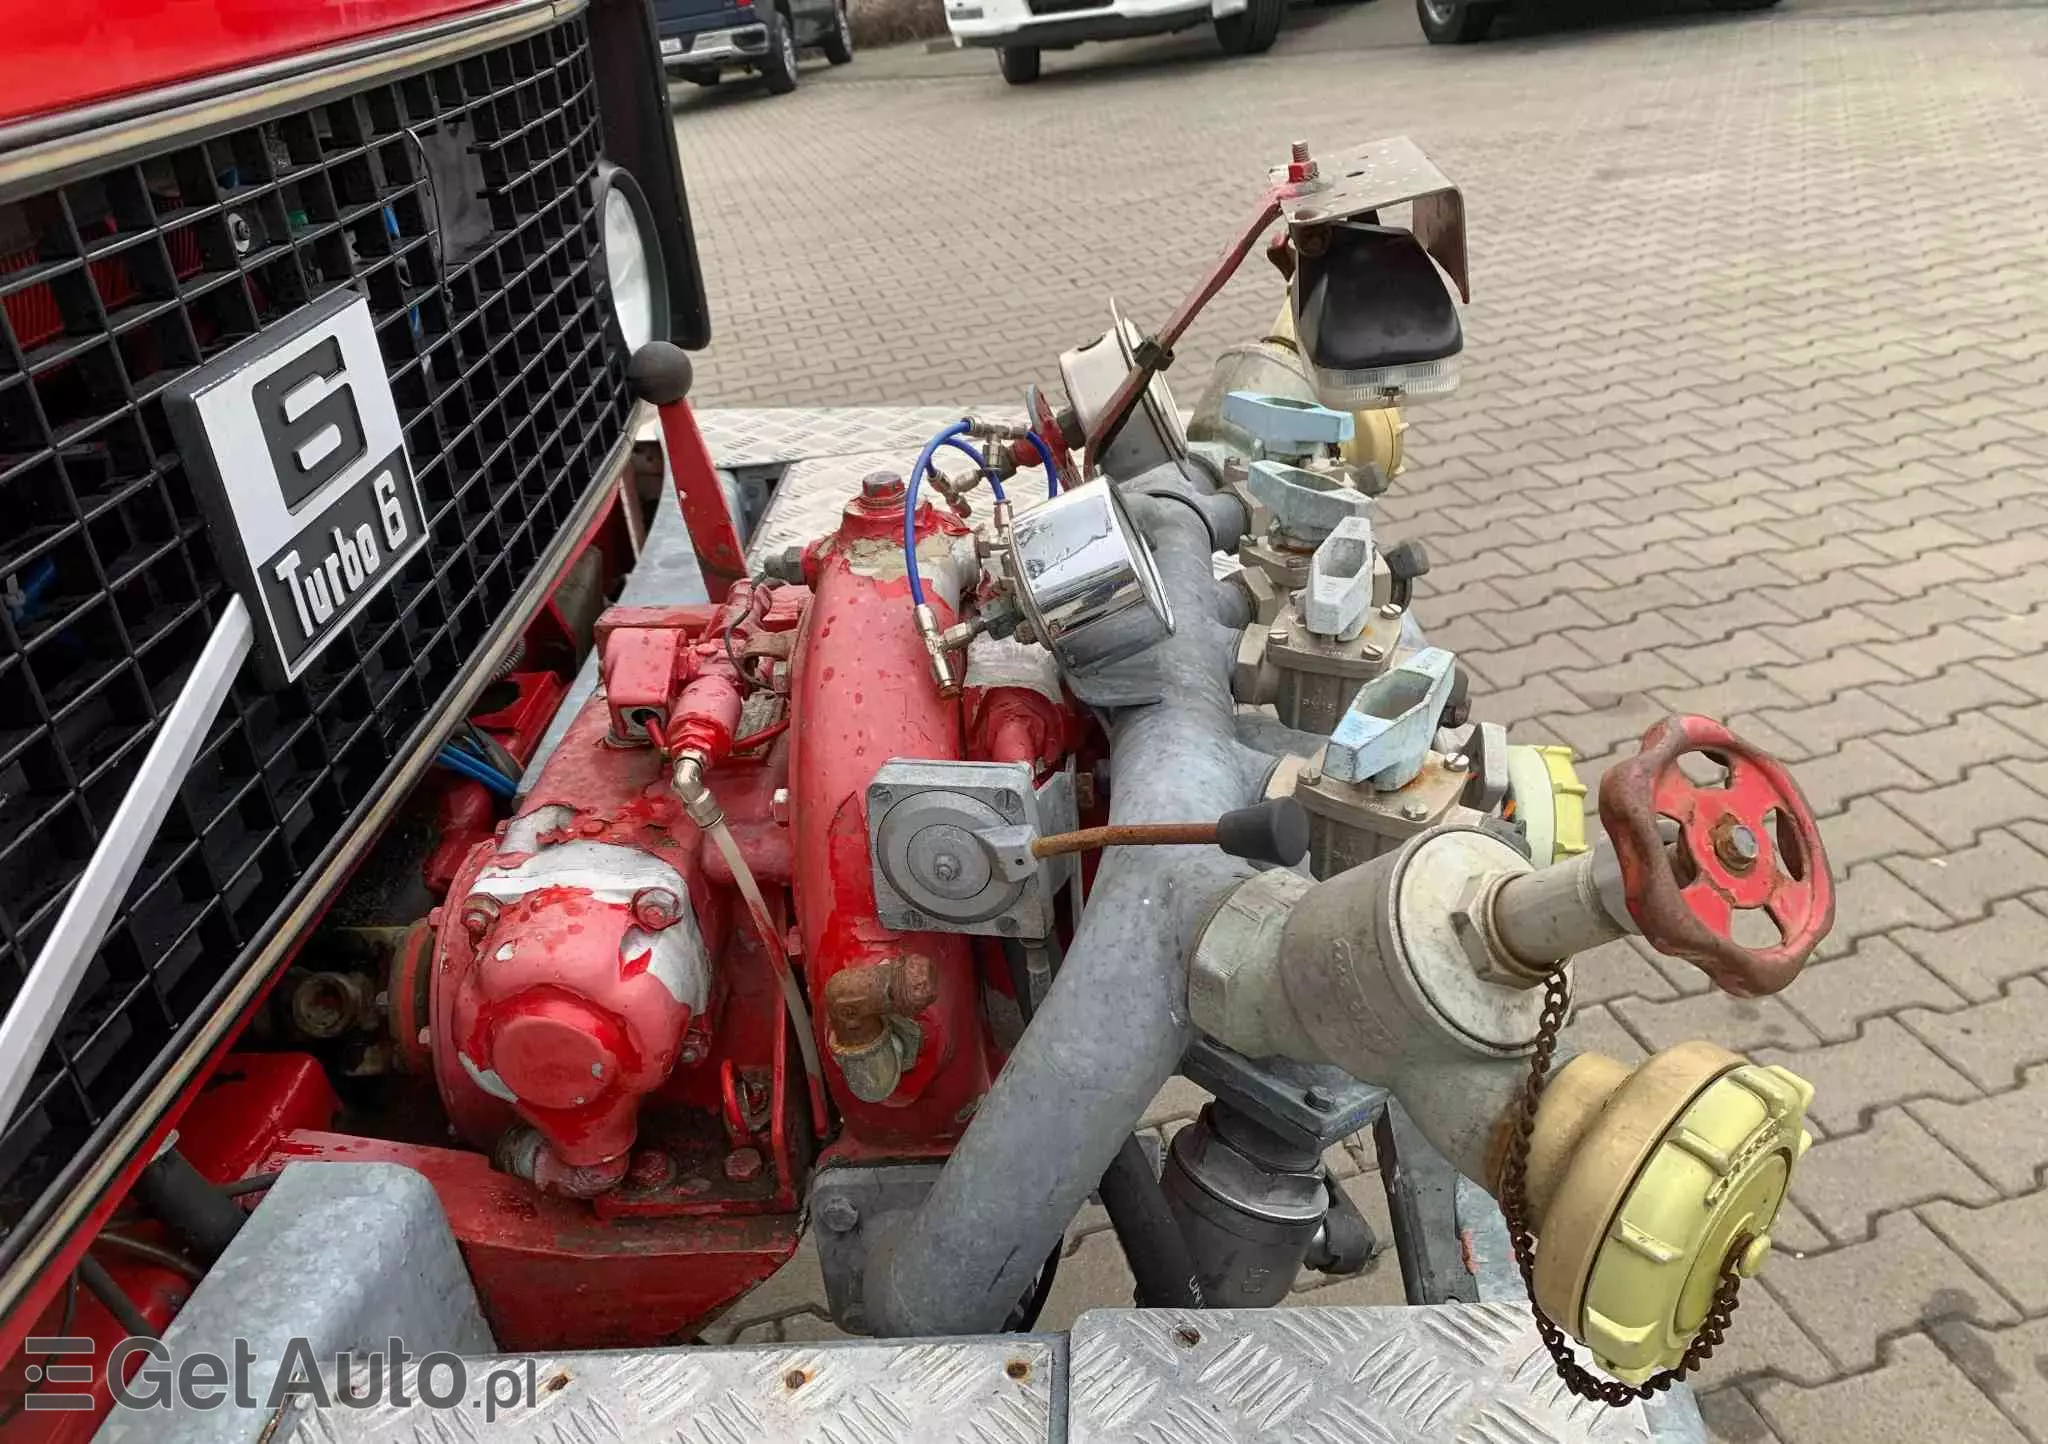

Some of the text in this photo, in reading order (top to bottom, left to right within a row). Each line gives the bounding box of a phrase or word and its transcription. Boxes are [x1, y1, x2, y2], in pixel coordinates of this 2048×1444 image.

[252, 334, 368, 516] 6
[274, 468, 407, 638] Turbo 6
